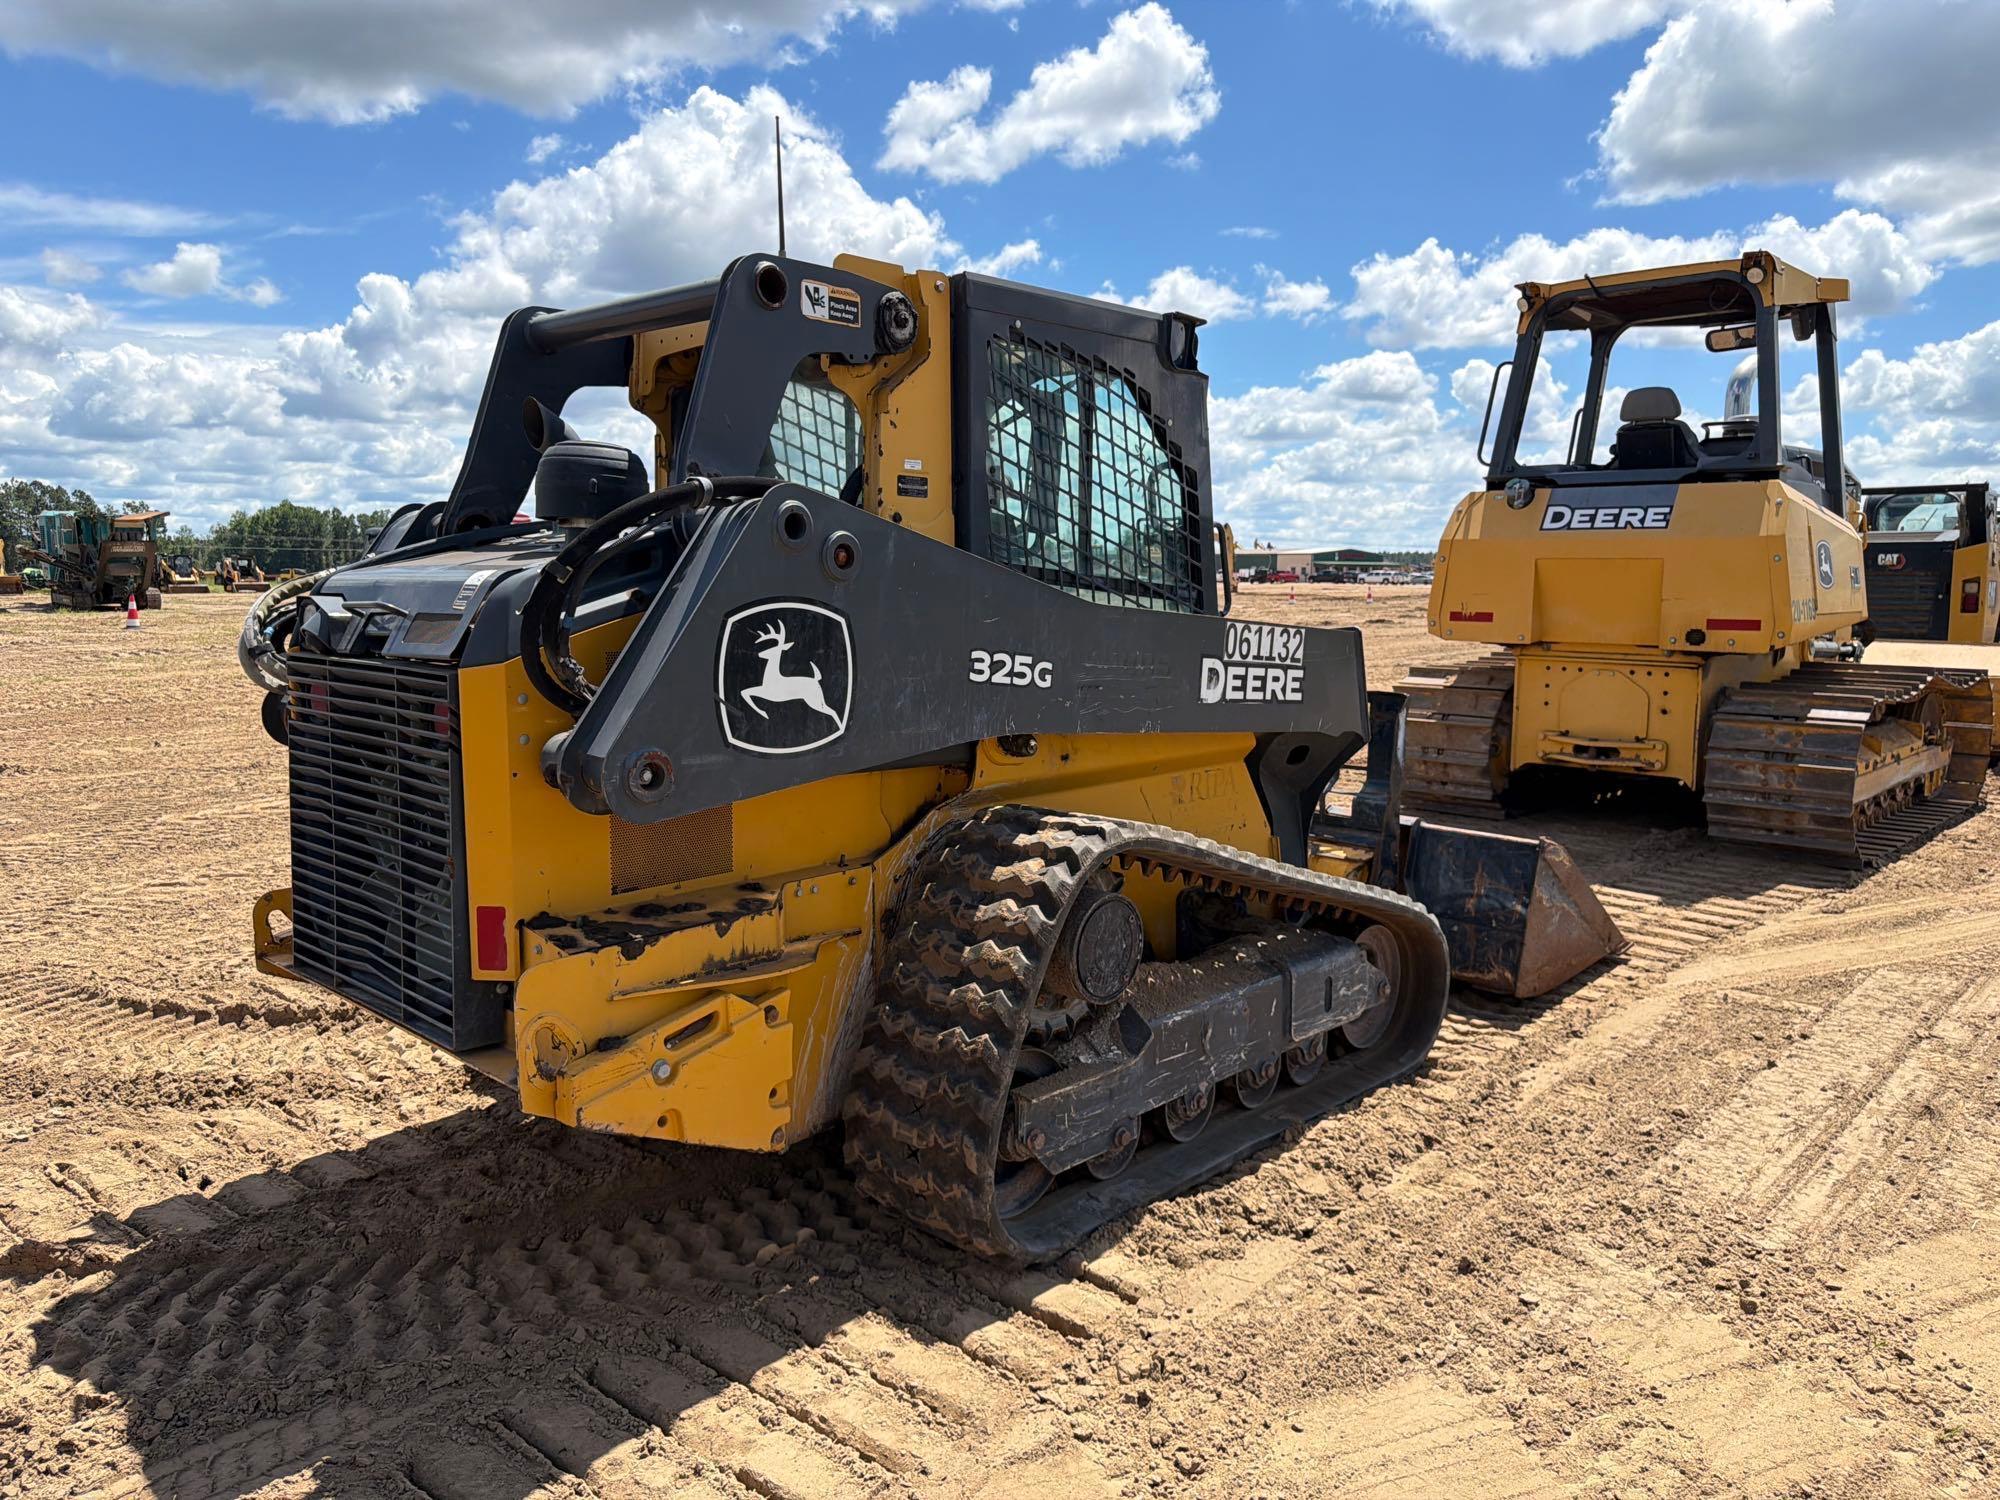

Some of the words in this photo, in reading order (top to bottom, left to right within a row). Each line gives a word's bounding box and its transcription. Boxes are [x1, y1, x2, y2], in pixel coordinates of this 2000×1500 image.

[830, 301, 845, 310] Pinch
[845, 304, 858, 312] Area
[842, 312, 854, 321] Away
[1541, 505, 1671, 530] DEERE
[1877, 553, 1900, 566] CAT
[1225, 622, 1304, 664] 061132
[968, 650, 1053, 688] 325G
[1201, 657, 1304, 704] DEERE
